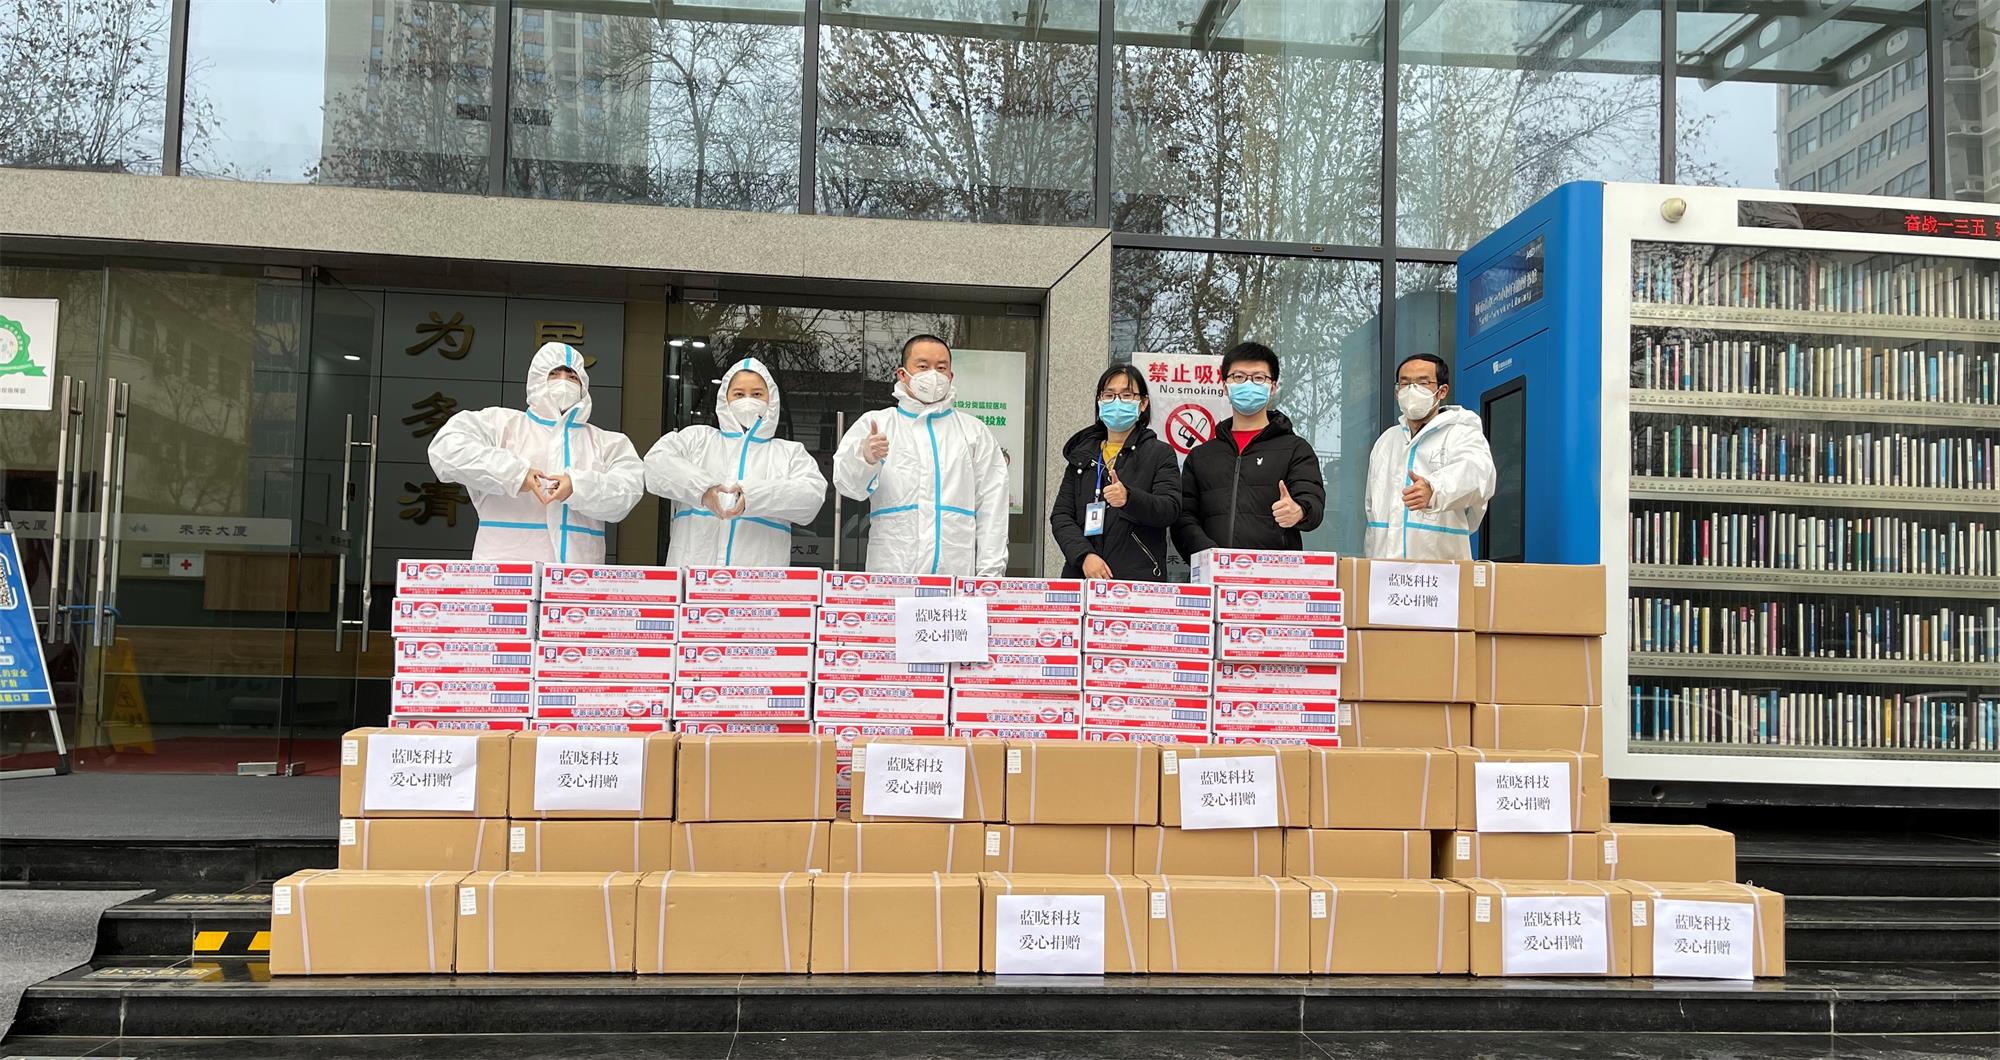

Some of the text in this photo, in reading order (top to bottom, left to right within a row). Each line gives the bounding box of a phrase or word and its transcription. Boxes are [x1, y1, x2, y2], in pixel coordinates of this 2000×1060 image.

[1904, 214, 1987, 236] 奋战一三五
[1159, 385, 1224, 398] No smoking
[178, 523, 249, 538] 未央大厦
[1388, 574, 1438, 588] 蓝晓科技
[1387, 594, 1438, 607] 爱心捐赠
[915, 608, 967, 622] 蓝晓科技
[914, 629, 968, 643] 爱心捐赠
[0, 667, 28, 678] 的安全
[392, 748, 452, 764] 蓝晓科技
[559, 749, 618, 765] 蓝晓科技
[887, 756, 942, 773] 蓝晓科技
[390, 772, 452, 787] 爱心捐赠
[558, 773, 618, 789] 爱心捐赠
[1200, 770, 1255, 785] 蓝晓科技
[1496, 775, 1549, 789] 蓝晓科技
[885, 779, 942, 796] 爱心捐赠
[1201, 791, 1256, 807] 爱心捐赠
[1496, 797, 1550, 811] 爱心捐赠
[1019, 909, 1080, 926] 蓝晓科技
[1523, 911, 1581, 927] 蓝晓科技
[1674, 914, 1730, 931] 蓝晓科技
[1019, 934, 1080, 950] 爱心捐赠
[1524, 935, 1583, 951] 爱心捐赠
[1674, 938, 1730, 955] 爱心捐赠
